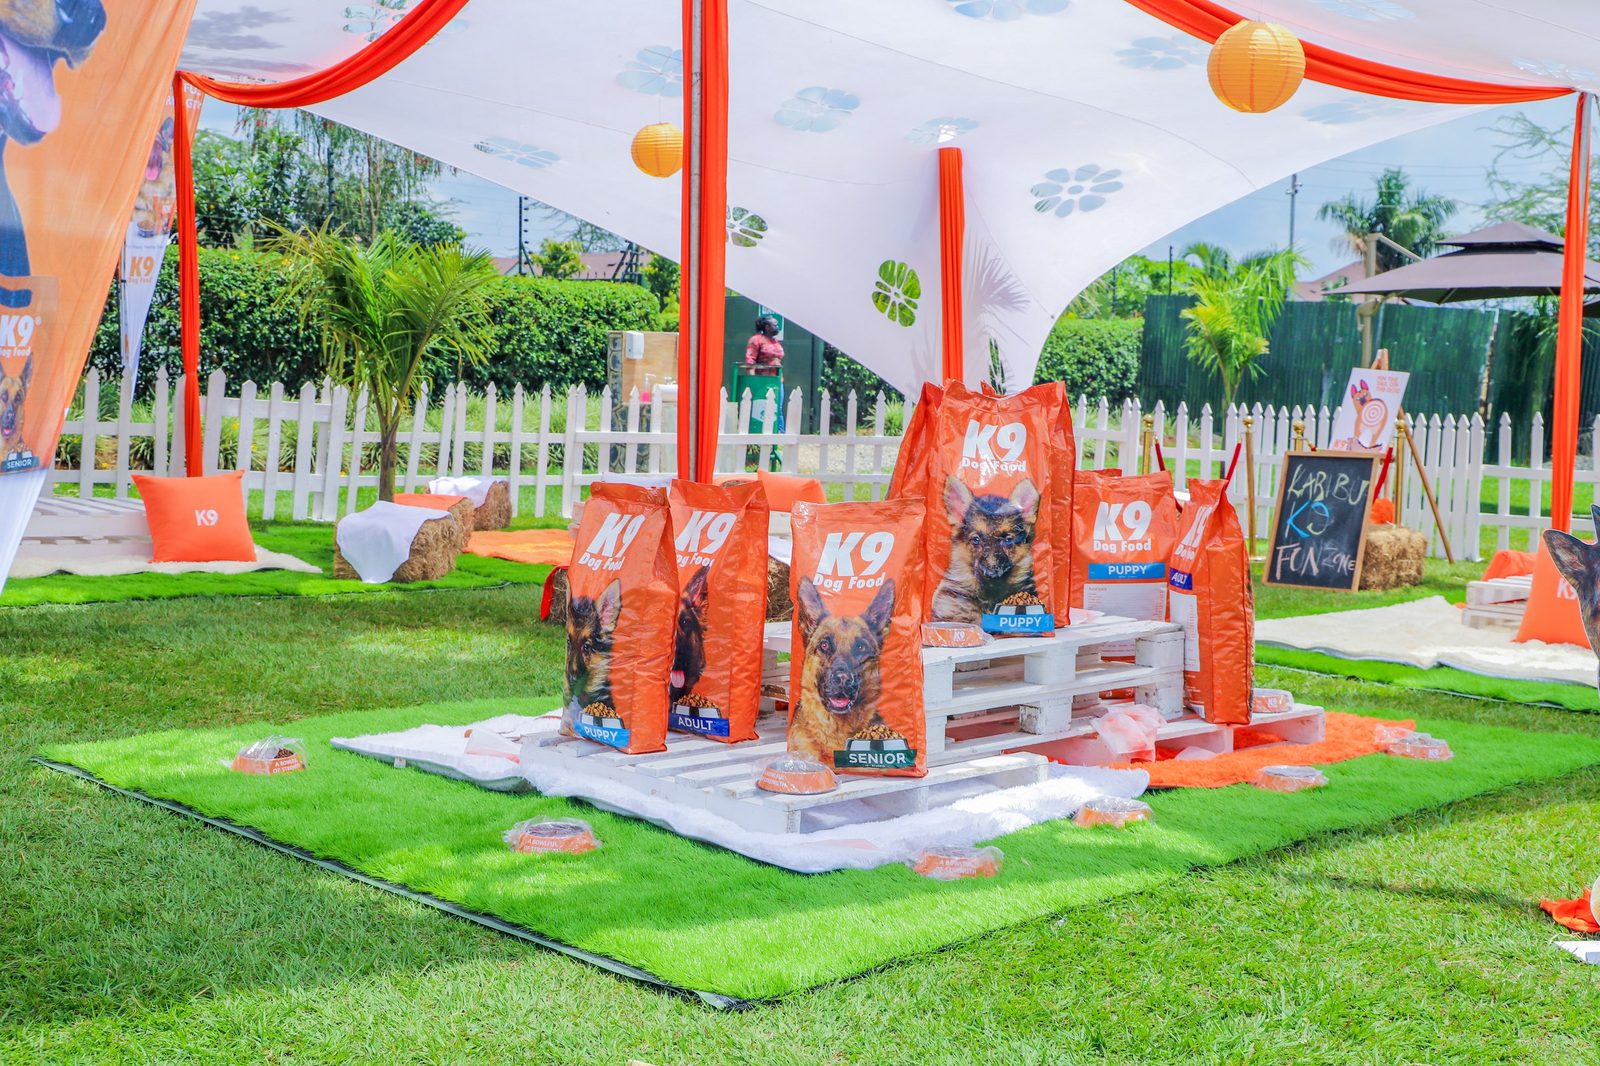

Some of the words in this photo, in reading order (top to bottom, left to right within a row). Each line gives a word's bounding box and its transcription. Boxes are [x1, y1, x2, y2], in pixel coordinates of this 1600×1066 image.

[129, 256, 154, 277] K9
[0, 314, 34, 347] K9
[961, 419, 1027, 462] K9
[7, 458, 32, 469] SENIOR
[1287, 463, 1369, 506] KARIBU
[195, 509, 219, 526] K9
[1093, 500, 1152, 541] K9
[1285, 499, 1330, 539] K9
[586, 512, 646, 558] K9
[675, 511, 737, 554] K9
[816, 531, 895, 577] K9
[1093, 540, 1117, 553] Dog
[1121, 538, 1152, 552] Food
[578, 552, 602, 571] Dog
[1108, 565, 1147, 575] PUPPY
[1276, 542, 1320, 580] FUN
[812, 572, 843, 592] Dog
[848, 572, 886, 588] Food
[1000, 616, 1042, 628] PUPPY
[679, 716, 713, 730] ADULT
[584, 726, 618, 742] PUPPY
[848, 752, 907, 765] SENIOR
